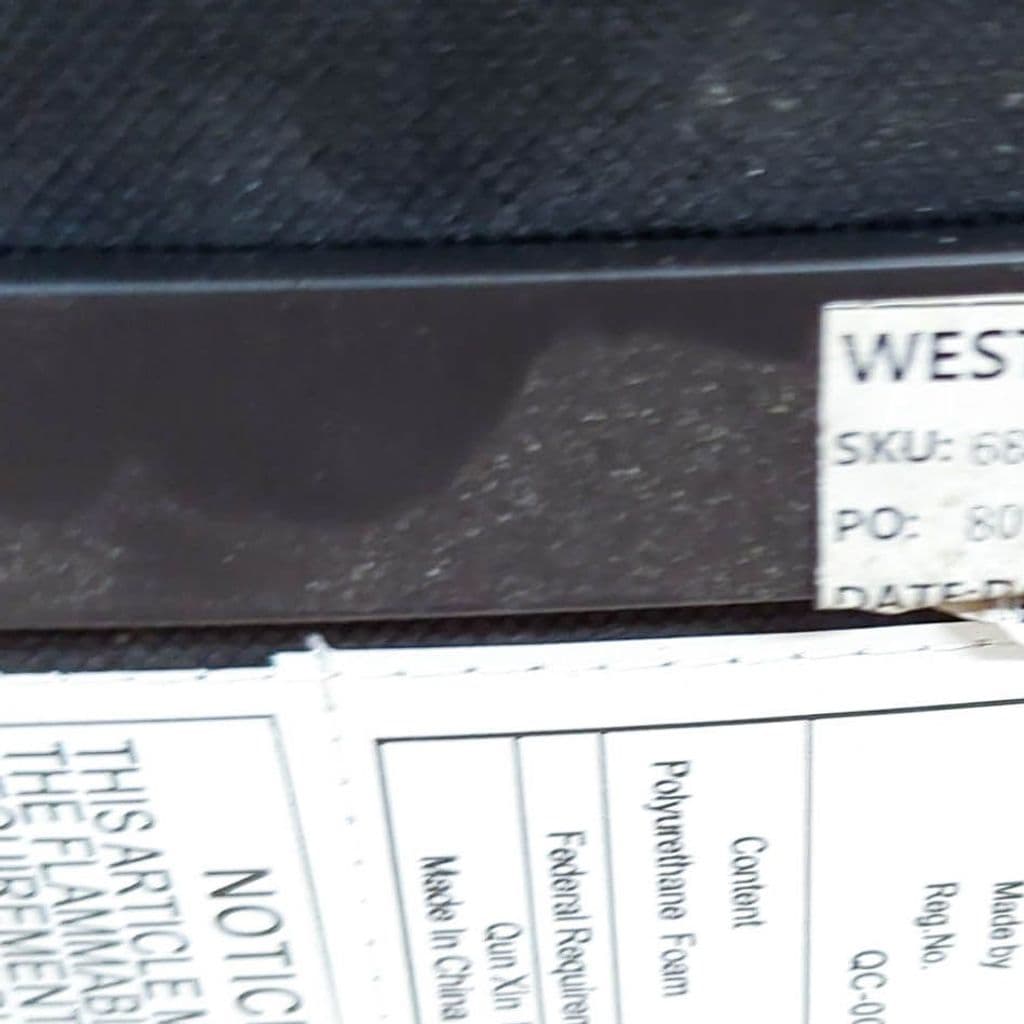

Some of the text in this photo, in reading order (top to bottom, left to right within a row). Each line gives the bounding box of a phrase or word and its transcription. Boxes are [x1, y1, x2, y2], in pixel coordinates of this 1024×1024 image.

[834, 428, 954, 465] SKU:
[833, 505, 920, 541] PO:
[2, 740, 84, 825] THE
[73, 738, 156, 833] THIS
[417, 855, 464, 921] Made
[546, 830, 591, 921] Federal
[641, 759, 696, 997] Polyurethane Foam
[727, 835, 770, 929] Content
[101, 842, 203, 998] ARTICLE
[429, 928, 466, 949] In
[482, 921, 528, 970] Qun
[431, 954, 476, 1021] China
[977, 944, 1020, 969] by
[491, 974, 531, 1011] Xin
